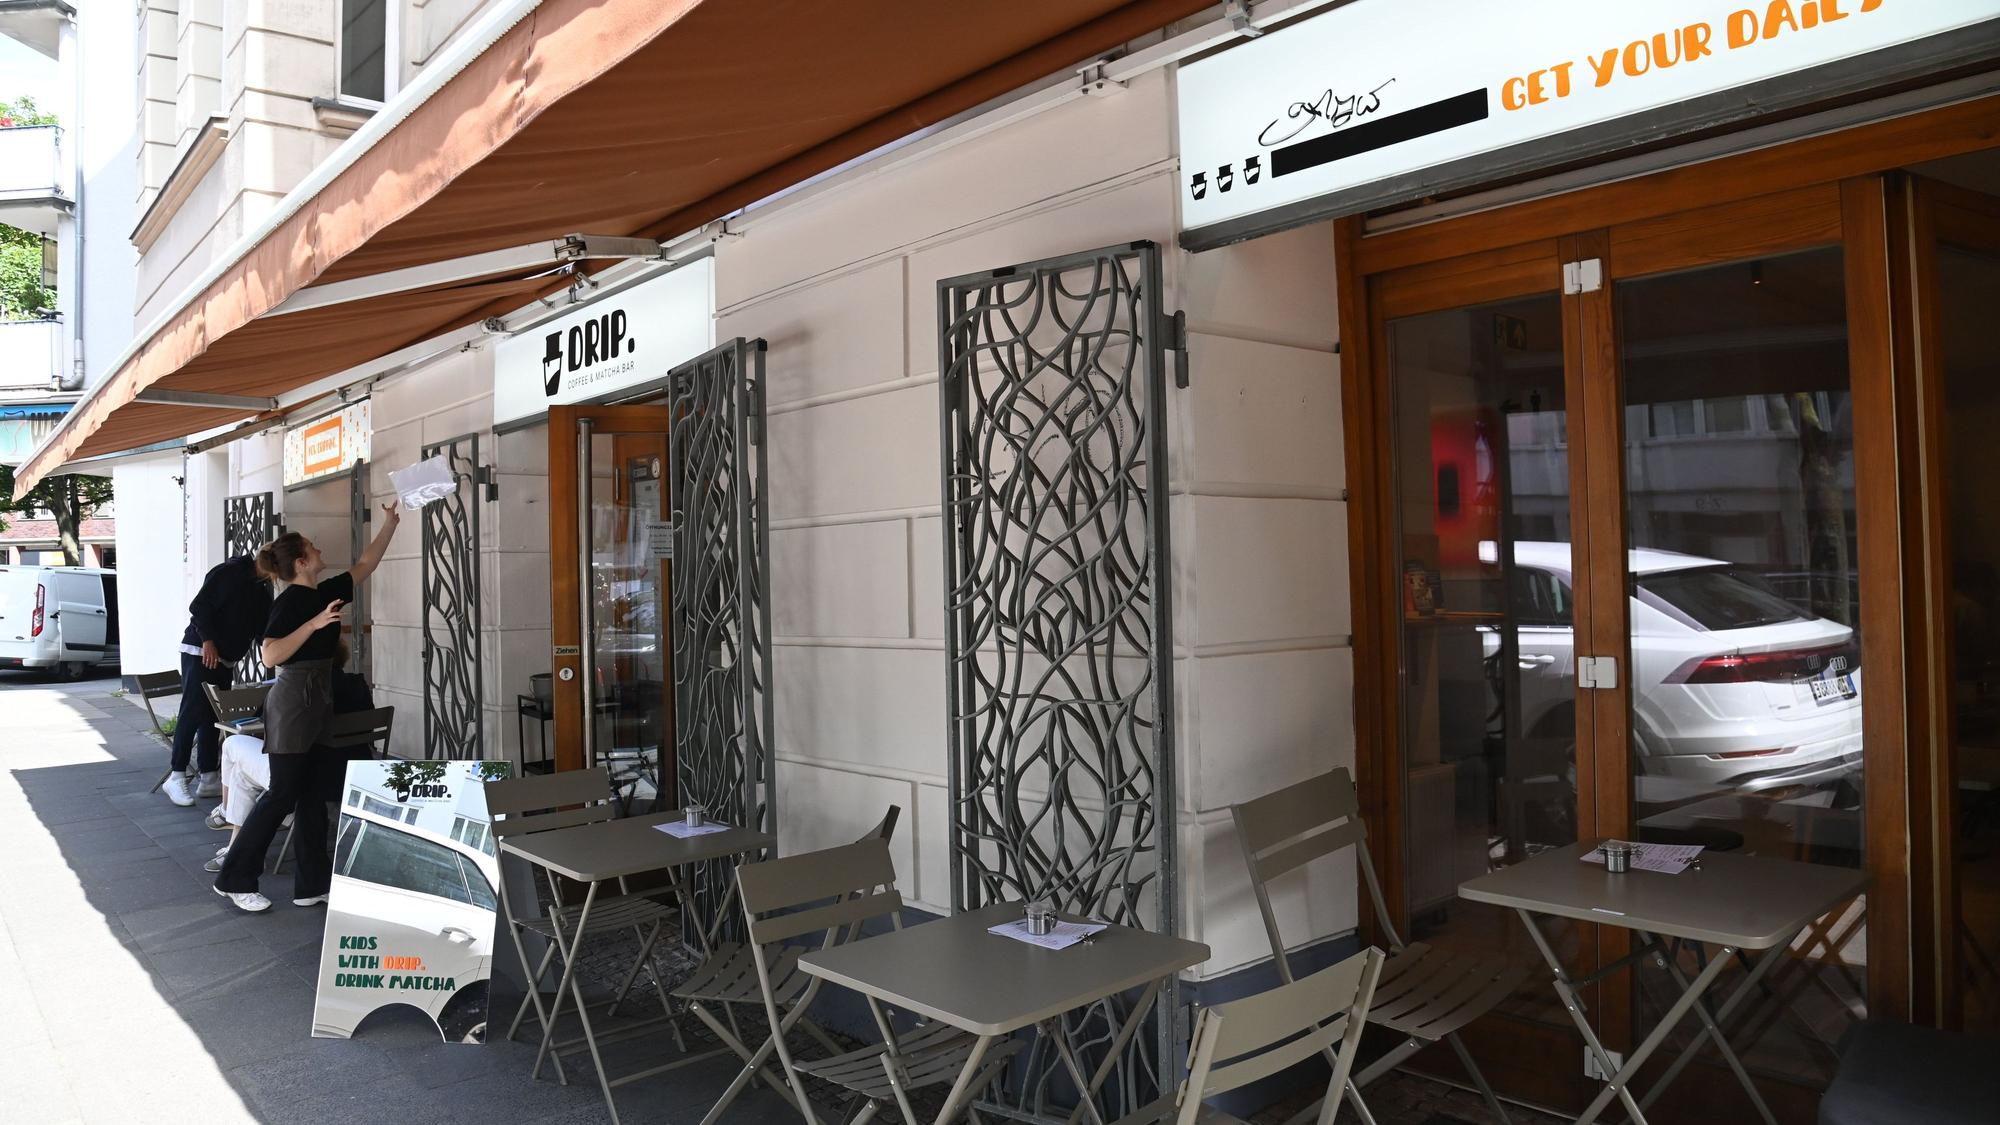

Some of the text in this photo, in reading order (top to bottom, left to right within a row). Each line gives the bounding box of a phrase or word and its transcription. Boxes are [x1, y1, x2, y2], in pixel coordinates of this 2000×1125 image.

[1501, 61, 1573, 111] GET
[1587, 22, 1712, 88] YOUR
[568, 309, 635, 372] DRIP.
[568, 375, 588, 389] COFFEE
[595, 366, 620, 380] MATCHA
[622, 361, 634, 373] BAR
[411, 785, 451, 798] DRIP.
[339, 936, 377, 950] KIDS
[338, 954, 426, 970] WITH DRIP.
[335, 973, 456, 991] DRINK MATCHA
